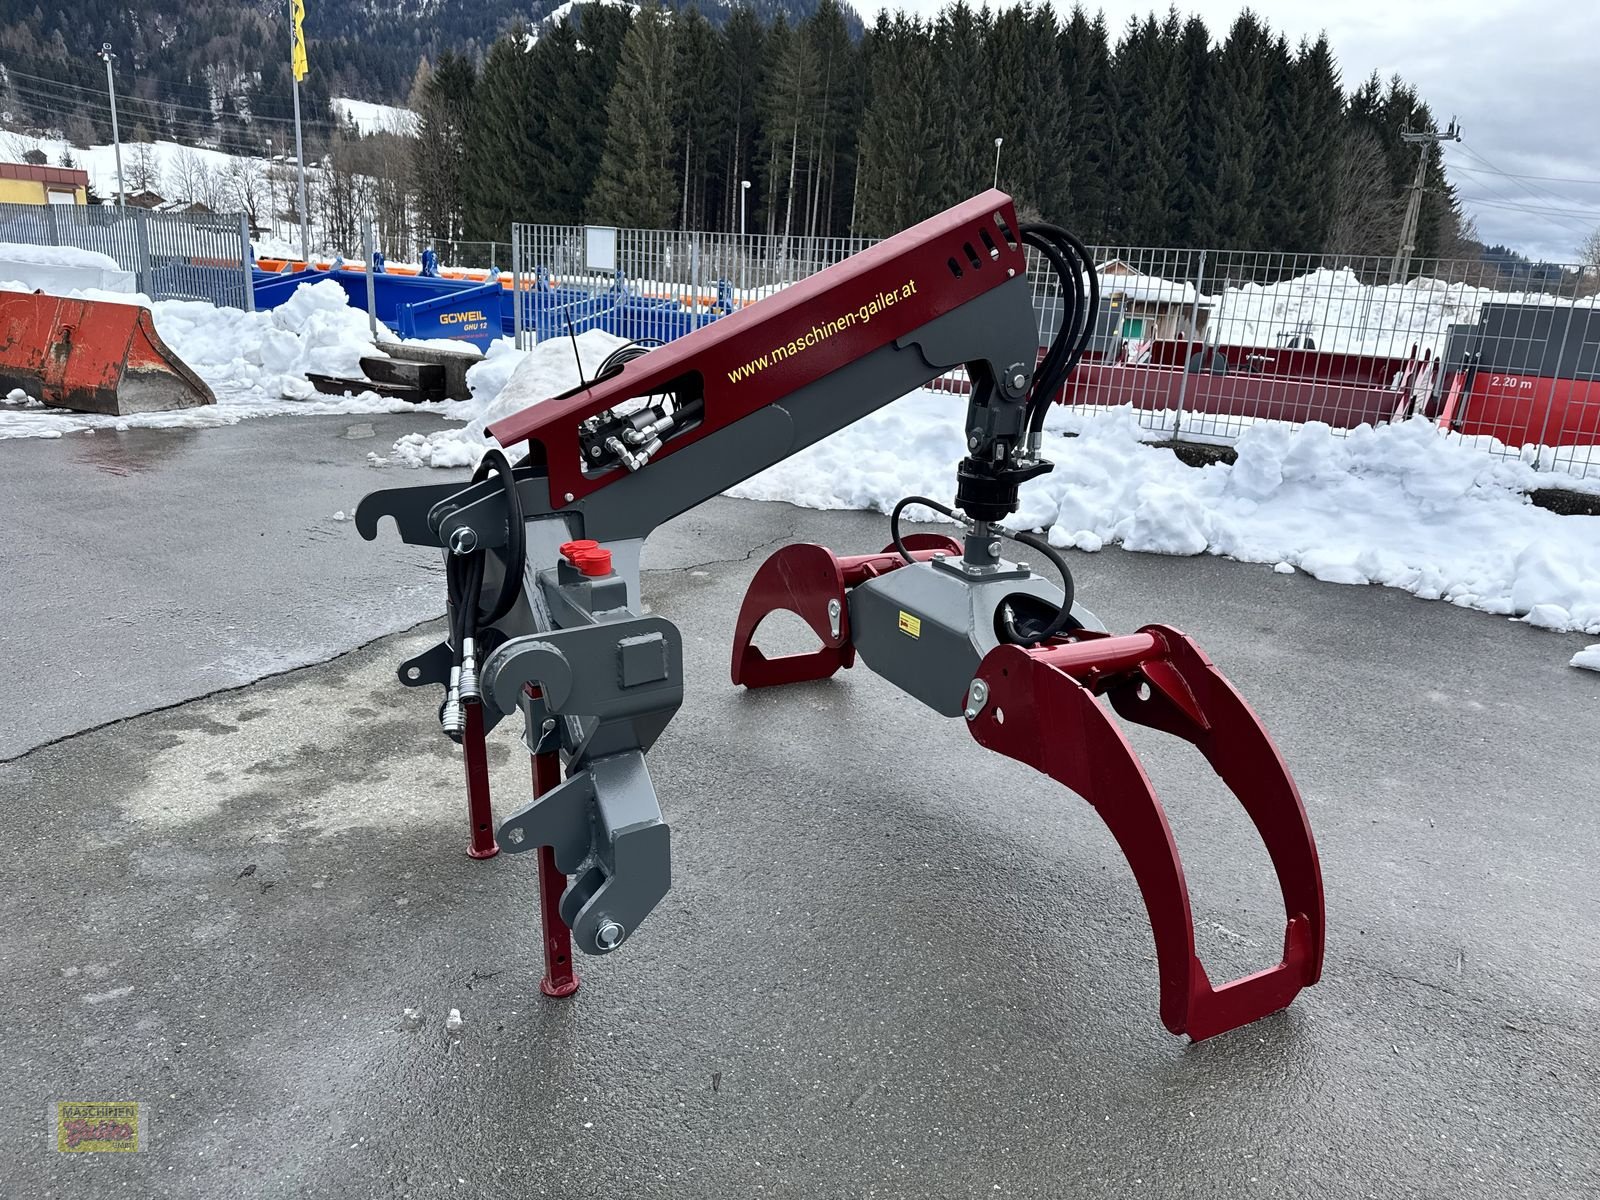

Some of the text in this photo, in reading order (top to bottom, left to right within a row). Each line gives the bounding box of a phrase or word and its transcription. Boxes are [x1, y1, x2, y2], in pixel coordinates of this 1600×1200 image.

[727, 279, 917, 384] www.maschinen-gailer.at
[1491, 376, 1533, 389] 2.20 m
